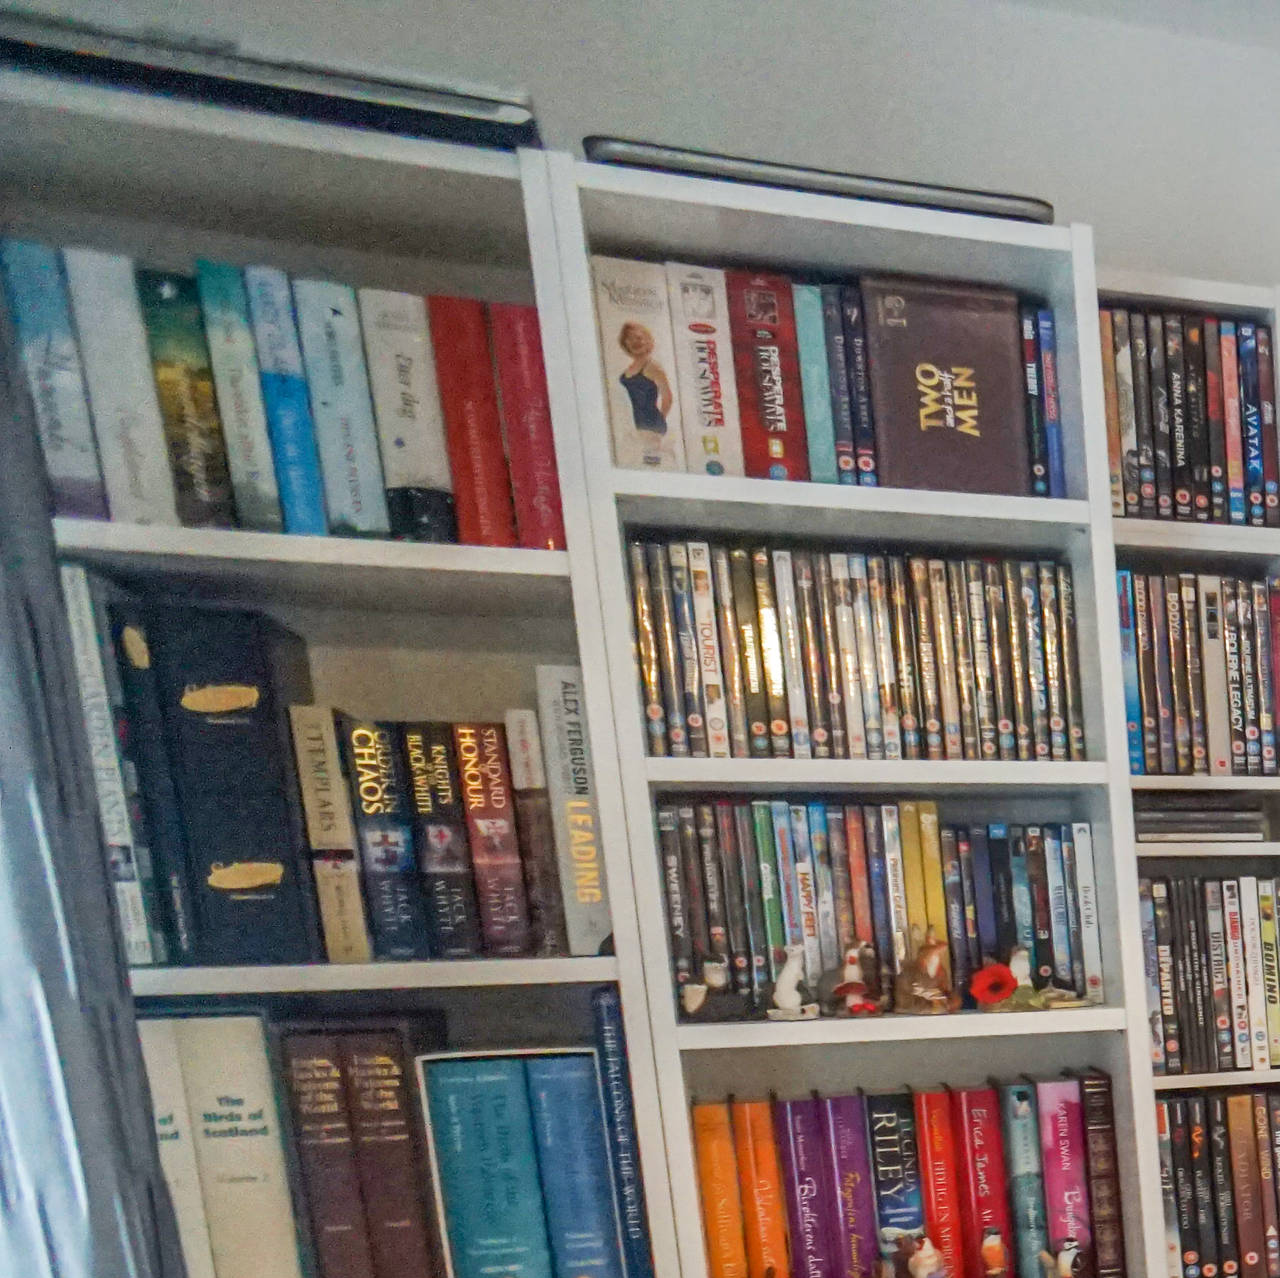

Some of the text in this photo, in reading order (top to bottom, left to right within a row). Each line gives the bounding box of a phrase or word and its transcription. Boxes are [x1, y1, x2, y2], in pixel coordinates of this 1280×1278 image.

[770, 346, 786, 432] DESPERATE
[915, 363, 944, 431] TWO
[952, 366, 981, 437] MEN
[1172, 373, 1186, 467] ANNA KARENINA
[1245, 404, 1260, 470] AVATAR
[1168, 593, 1180, 629] BODY
[700, 621, 717, 675] TOURIST
[1227, 633, 1242, 732] BOURNE LEGACY
[1245, 675, 1255, 720] ULTIMATUM
[350, 727, 384, 815] CHAOS
[457, 727, 485, 811] HONOUR
[480, 728, 506, 809] STANDARD
[560, 681, 589, 795] ALEX FERGUSON
[432, 745, 452, 804] KNIGHTS
[566, 800, 602, 903] LEADING
[799, 872, 812, 908] HAPPY
[1229, 912, 1241, 940] DJANGO
[1263, 941, 1278, 1005] DOMINO
[872, 1112, 905, 1203] RILEY
[971, 1109, 990, 1198] Erica James
[1056, 1103, 1071, 1171] KAREN SWAN
